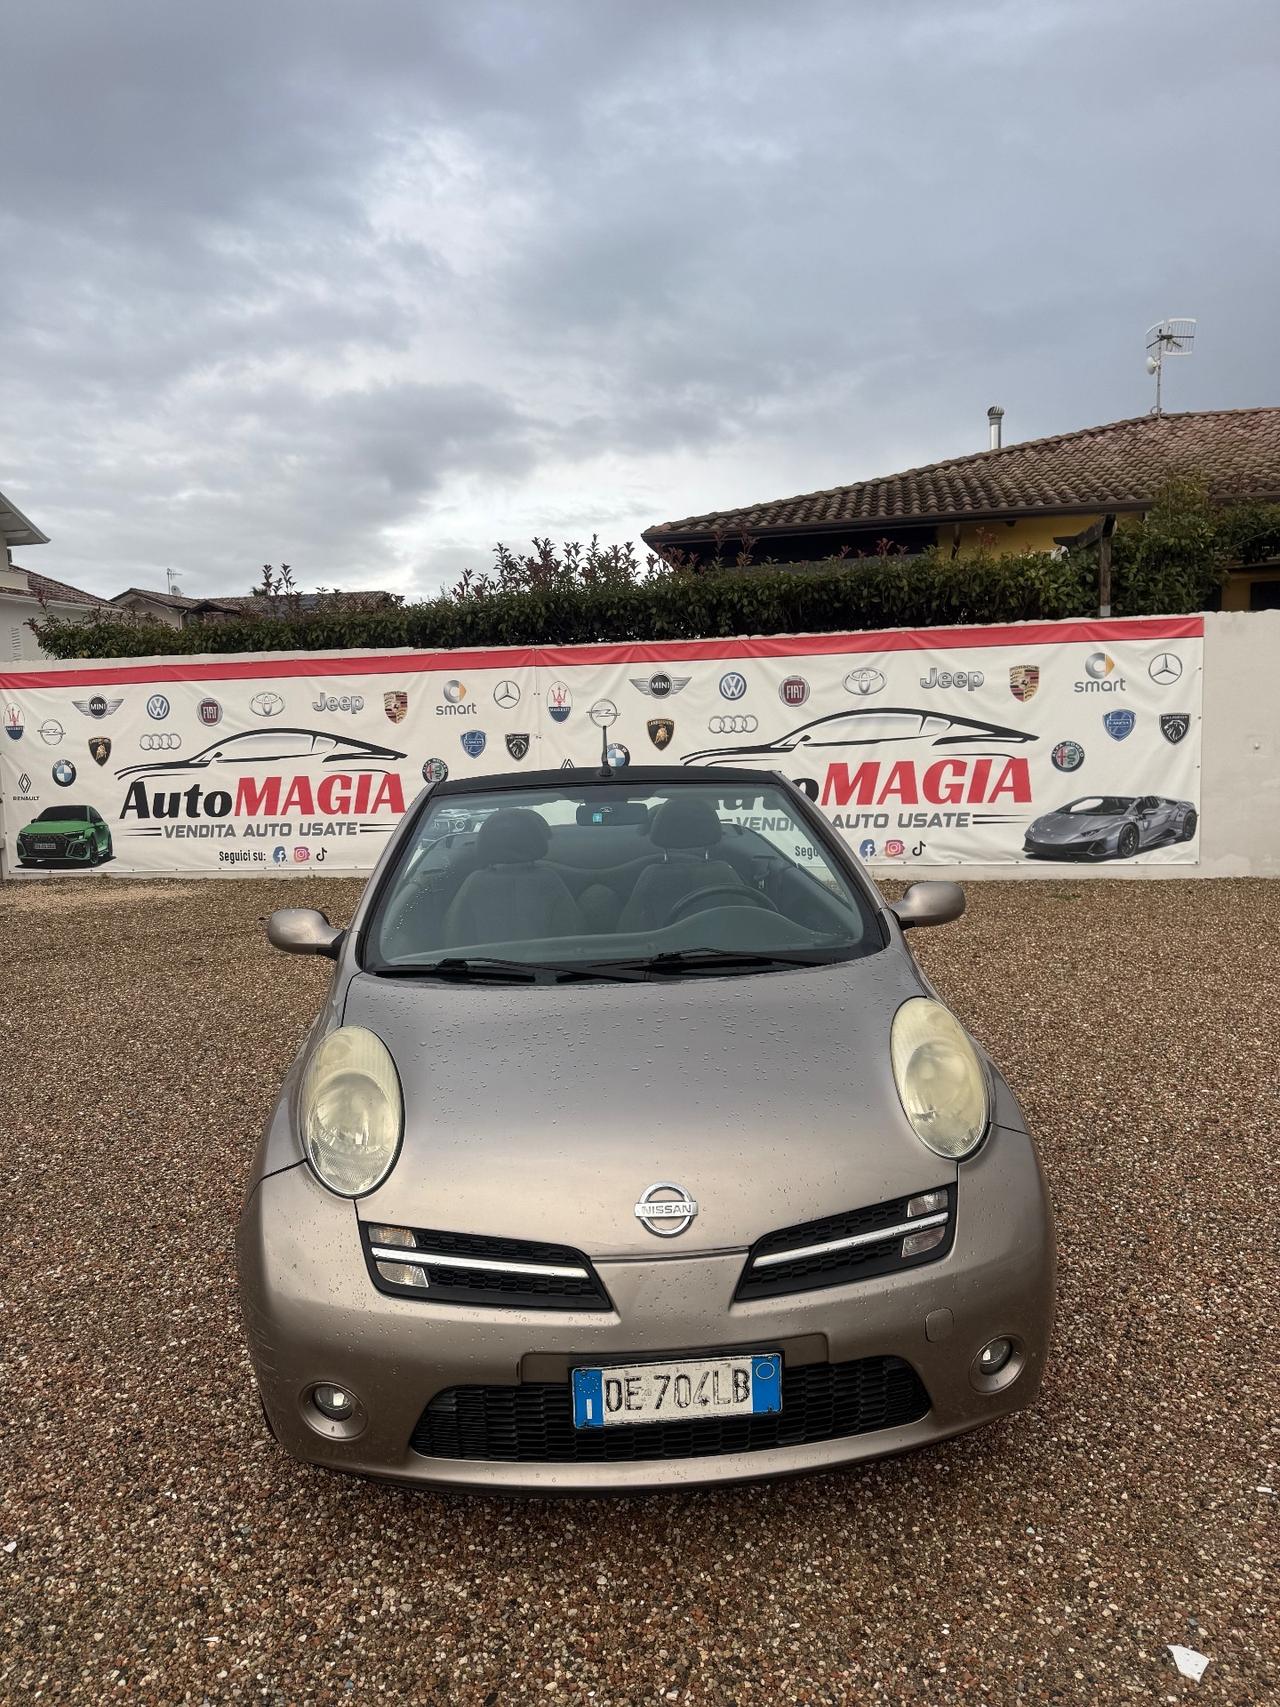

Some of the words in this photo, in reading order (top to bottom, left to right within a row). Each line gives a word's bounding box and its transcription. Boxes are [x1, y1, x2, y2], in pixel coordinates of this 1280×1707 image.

[651, 681, 670, 689] MINI
[920, 667, 985, 691] Jeep
[1074, 678, 1126, 693] smart
[786, 684, 804, 699] FIAT
[90, 702, 107, 710] MINI
[312, 692, 364, 714] Jeep
[435, 702, 477, 716] smart
[202, 705, 219, 720] FIAT
[119, 773, 407, 819] AutoMAGIA
[831, 813, 890, 829] AUTO
[897, 812, 971, 828] USATE
[164, 823, 236, 838] VENDITA
[243, 823, 292, 837] AUTO
[299, 822, 358, 836] USATE
[219, 850, 251, 864] Seguici
[253, 852, 266, 862] su:
[640, 1204, 692, 1215] NISSAN
